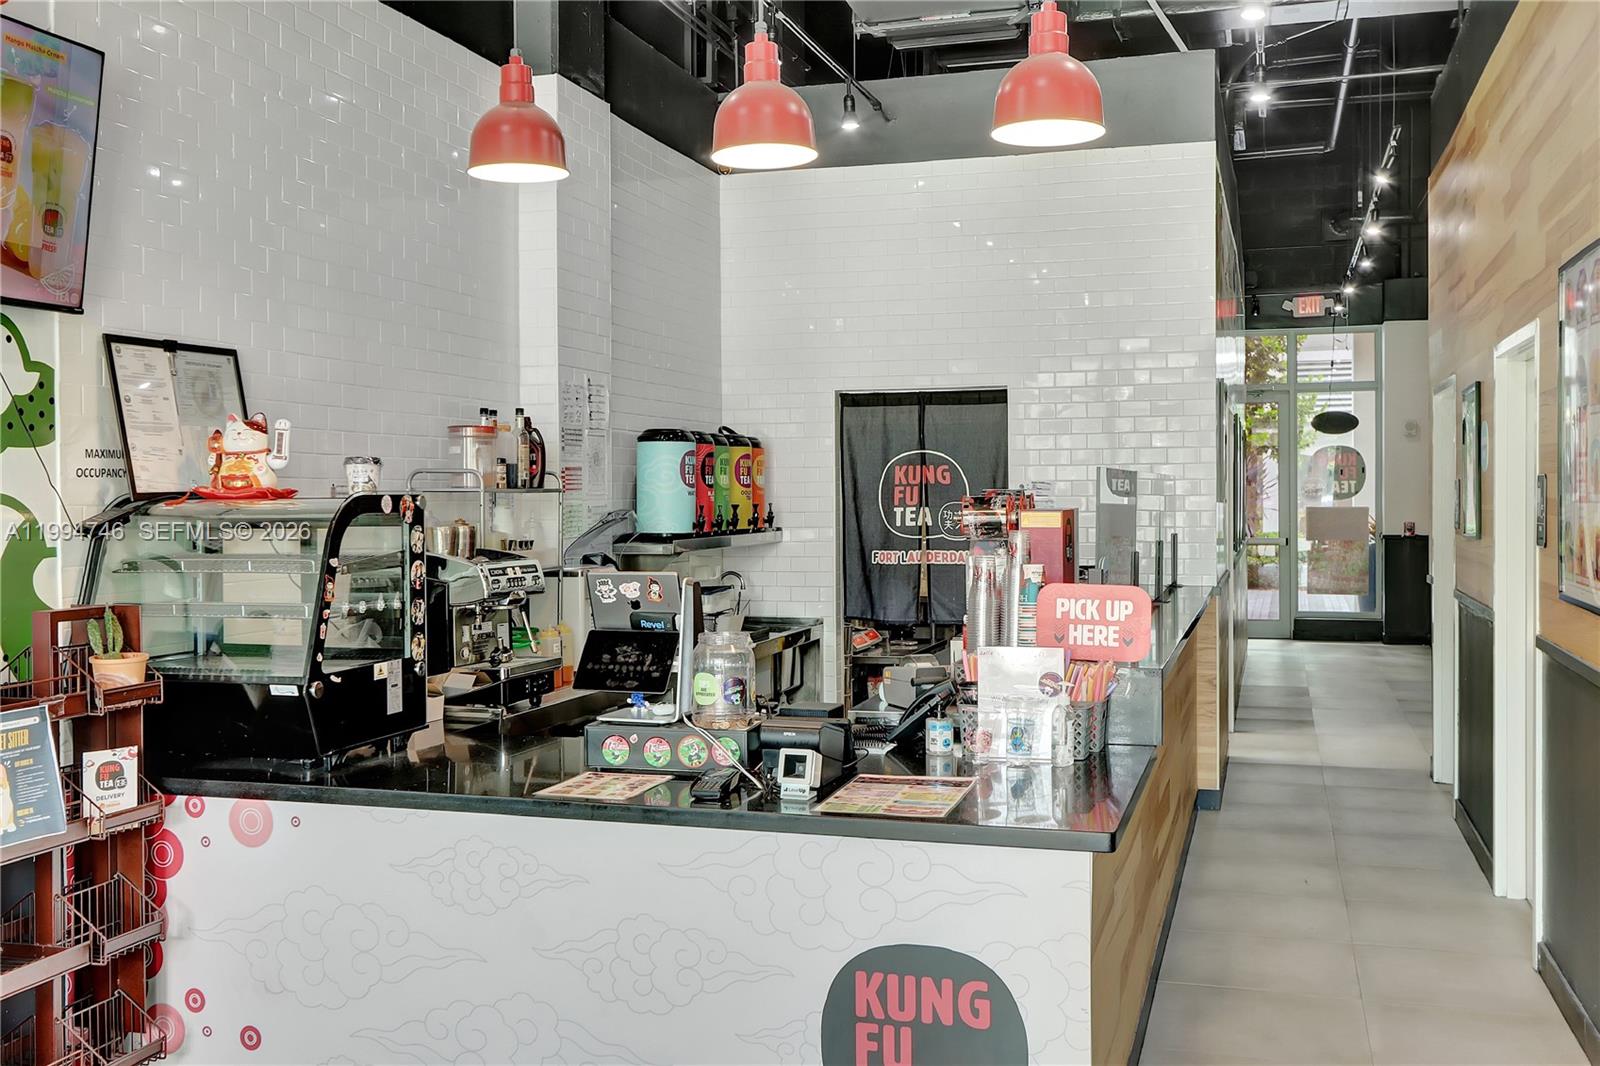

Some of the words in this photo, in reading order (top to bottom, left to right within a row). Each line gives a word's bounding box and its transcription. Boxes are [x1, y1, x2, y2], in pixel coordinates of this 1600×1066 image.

[1299, 297, 1320, 314] EXIT
[76, 467, 127, 478] OCCUPANCY
[893, 464, 952, 486] KUNG
[1111, 478, 1130, 491] TEA
[893, 486, 919, 506] FU
[893, 506, 933, 526] TEA
[872, 550, 899, 564] FORT
[900, 550, 969, 564] LAUDERDA
[1056, 597, 1100, 621] PICK
[1105, 599, 1134, 622] UP
[640, 620, 665, 629] Revel
[1068, 623, 1120, 648] HERE
[99, 763, 121, 773] KUNG
[99, 772, 109, 781] FU
[99, 779, 114, 789] TEA
[96, 792, 125, 801] DELIVERY
[854, 970, 992, 1031] KUNG
[854, 1021, 914, 1066] FU
